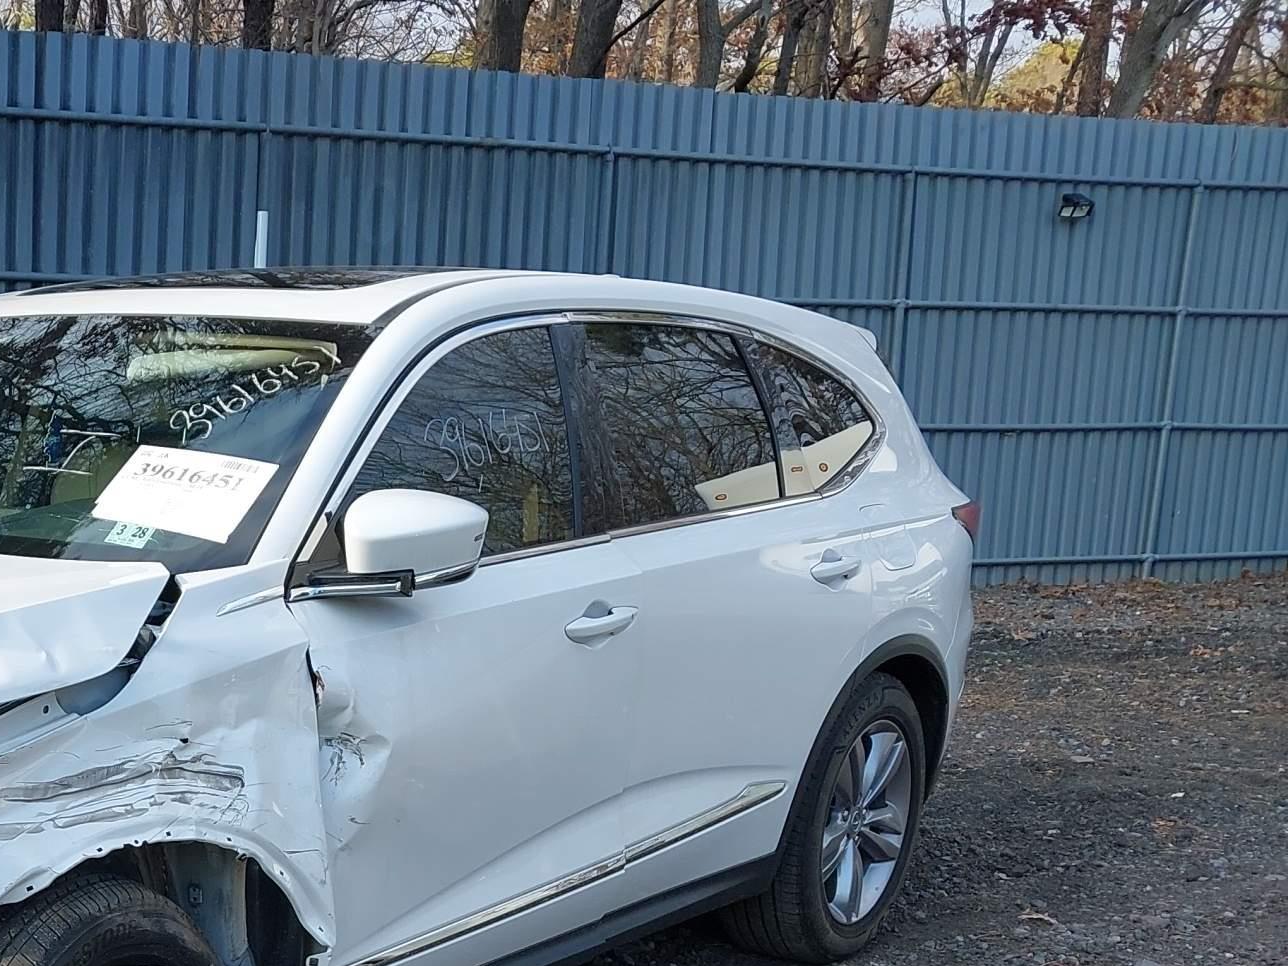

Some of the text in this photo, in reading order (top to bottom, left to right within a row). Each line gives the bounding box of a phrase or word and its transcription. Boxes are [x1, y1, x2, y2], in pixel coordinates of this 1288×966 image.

[133, 462, 245, 491] 39616451
[116, 524, 150, 539] 3 28
